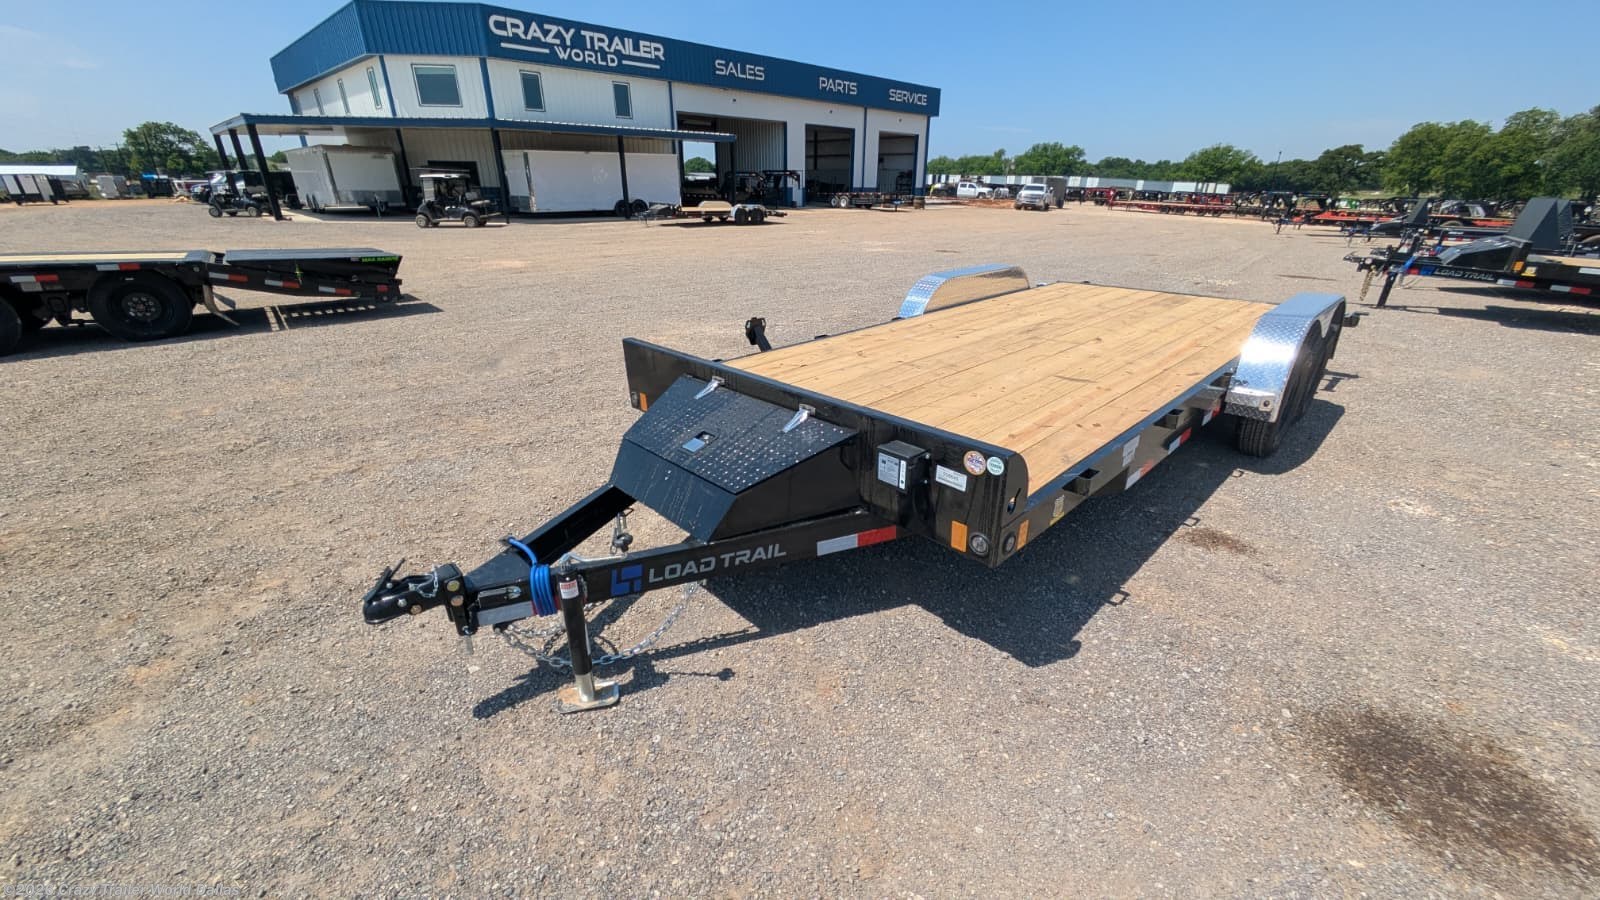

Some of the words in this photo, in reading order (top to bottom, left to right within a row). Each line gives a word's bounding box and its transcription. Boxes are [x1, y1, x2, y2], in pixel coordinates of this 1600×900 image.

[489, 15, 575, 46] CRAZY
[580, 30, 665, 60] TRAILER
[554, 46, 618, 67] WORLD
[715, 60, 765, 81] SALES
[819, 77, 857, 95] PARTS
[889, 89, 927, 106] SERVICE
[1434, 268, 1462, 277] LOAD
[1463, 271, 1495, 281] TRAIL
[648, 556, 716, 583] LOAD
[720, 543, 787, 568] TRAIL
